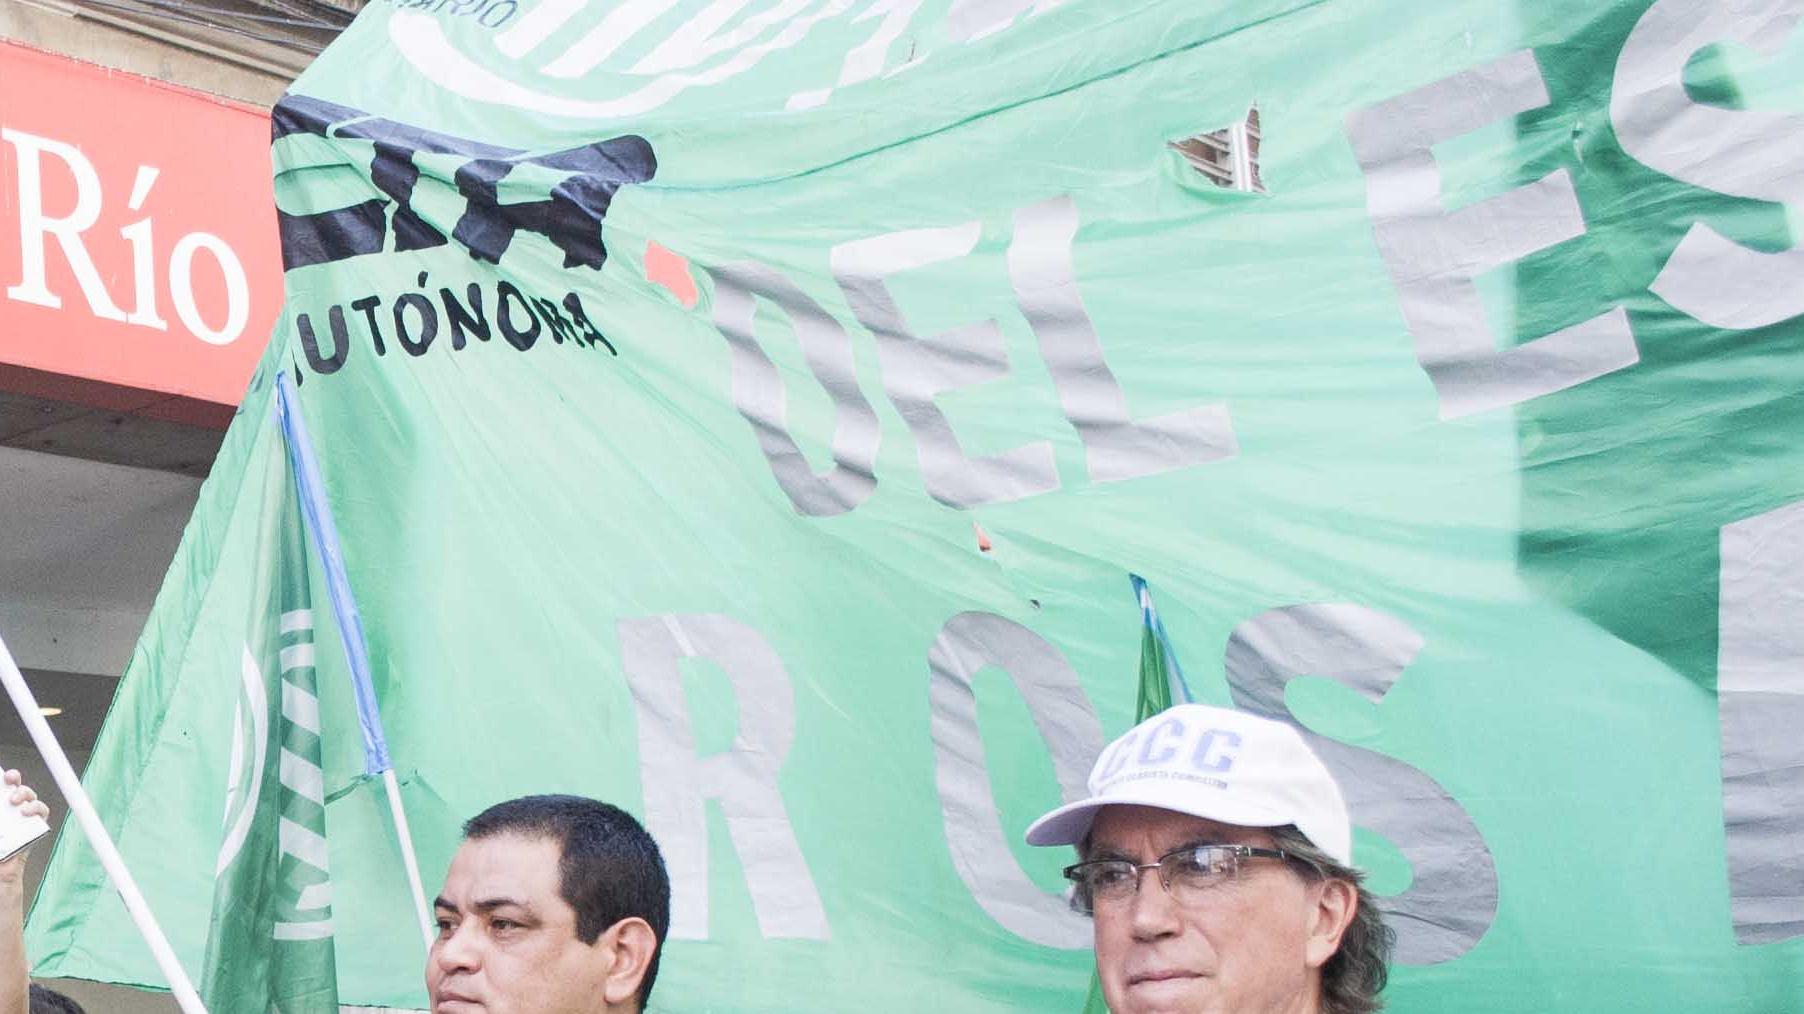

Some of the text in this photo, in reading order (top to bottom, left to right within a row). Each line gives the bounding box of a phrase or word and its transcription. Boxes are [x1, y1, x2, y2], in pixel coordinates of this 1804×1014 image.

[2, 128, 250, 345] Río
[290, 271, 618, 386] UTÓNOMA
[706, 193, 1239, 517] DEL
